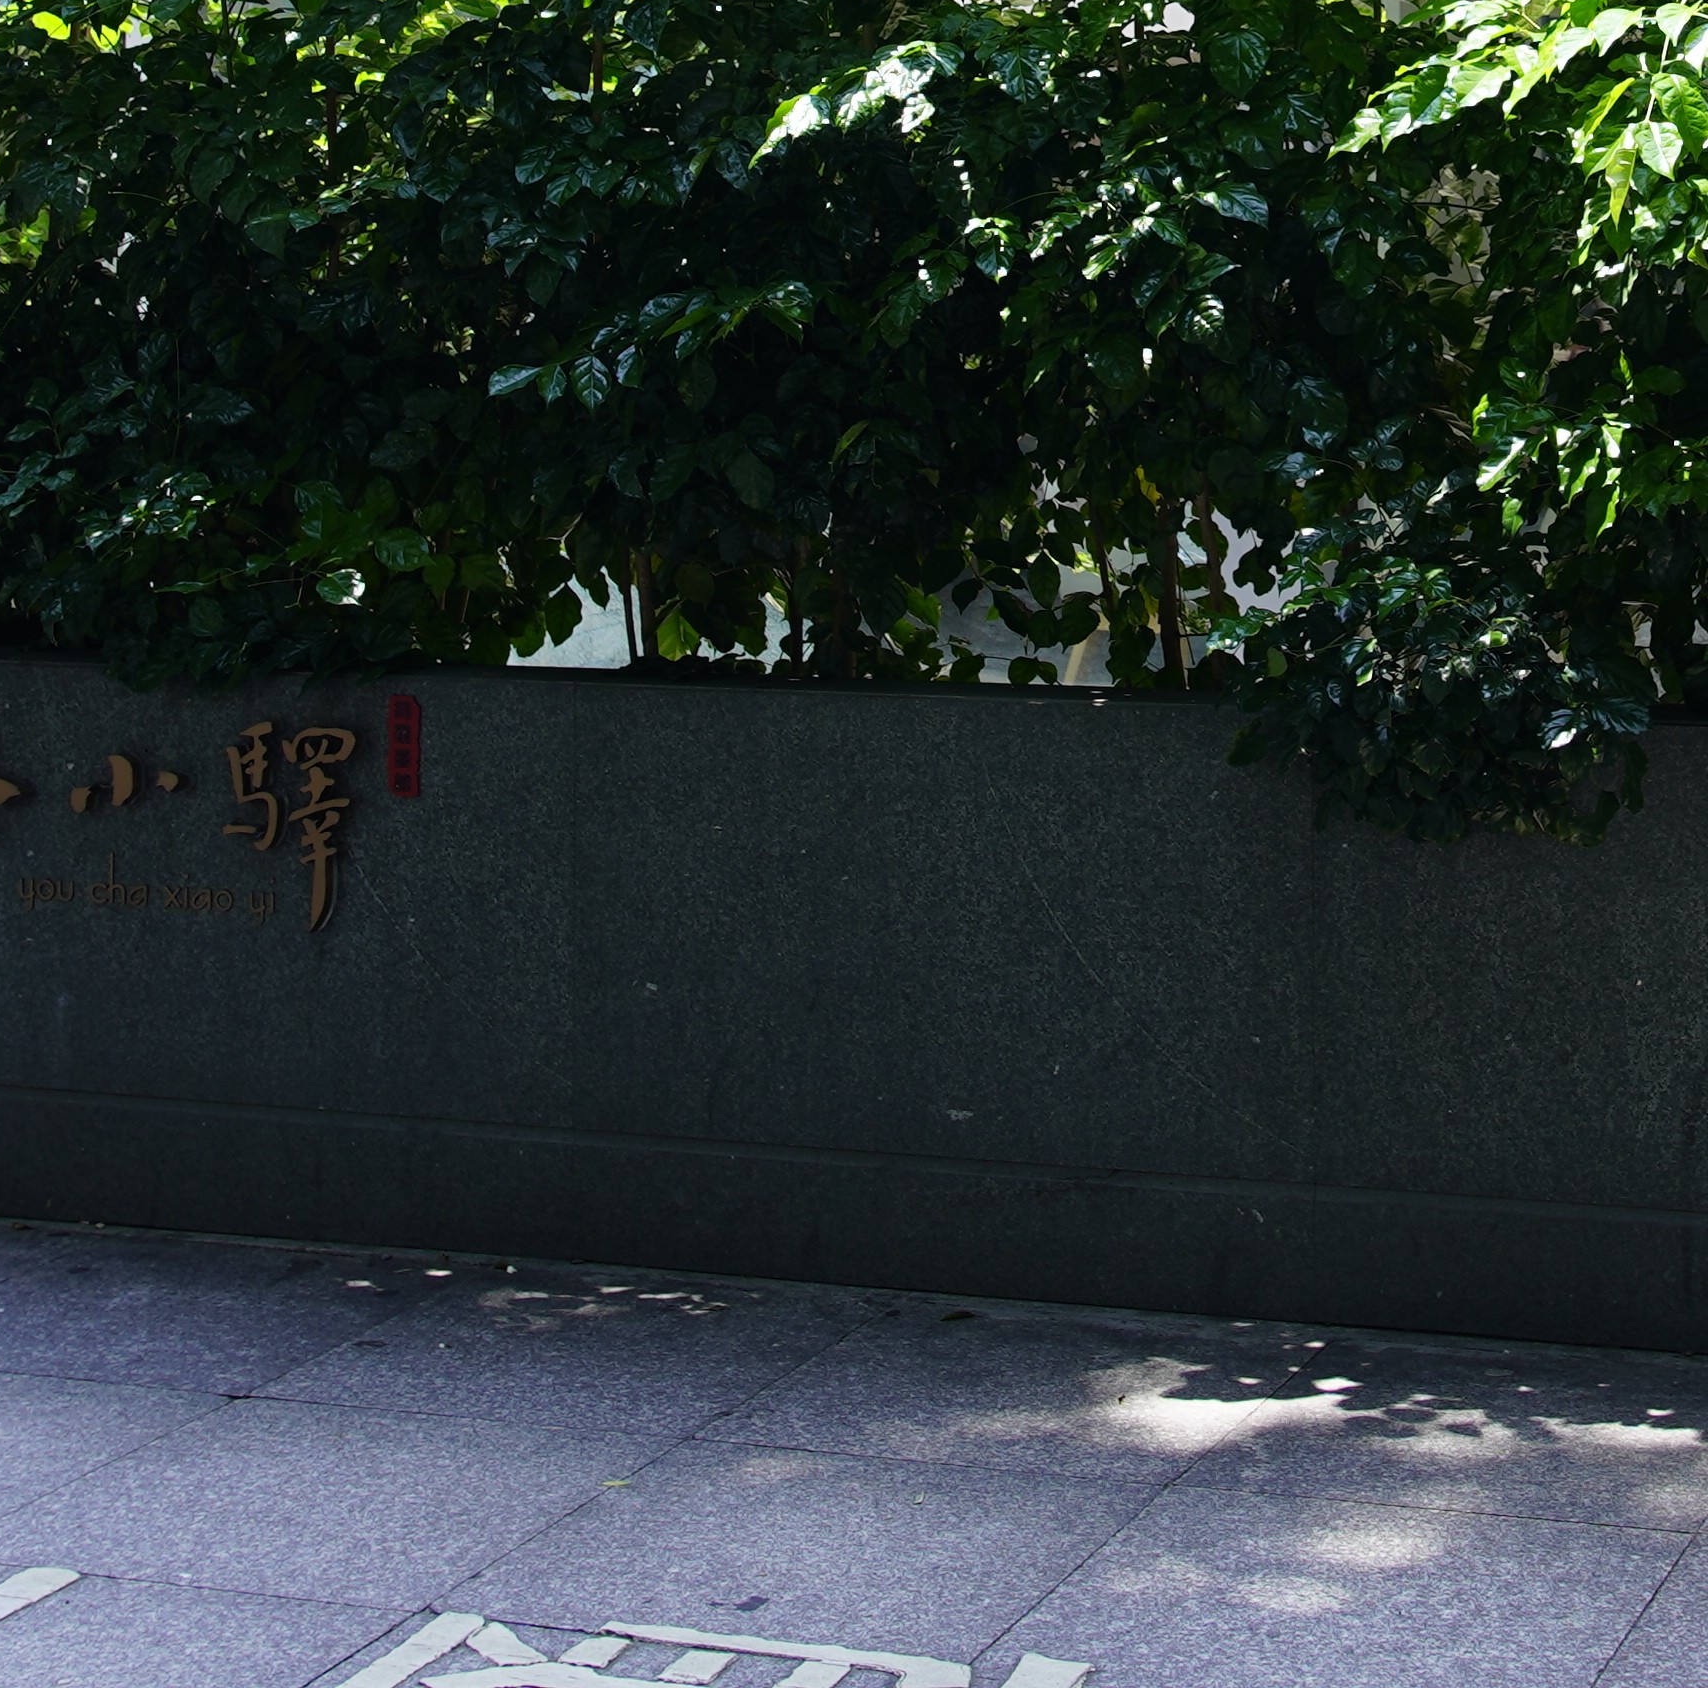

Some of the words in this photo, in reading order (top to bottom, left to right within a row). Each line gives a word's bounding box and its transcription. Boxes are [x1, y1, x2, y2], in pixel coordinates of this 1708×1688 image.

[19, 877, 75, 912] you
[91, 852, 149, 908] cha
[163, 873, 244, 912] xiao
[249, 877, 278, 926] yi
